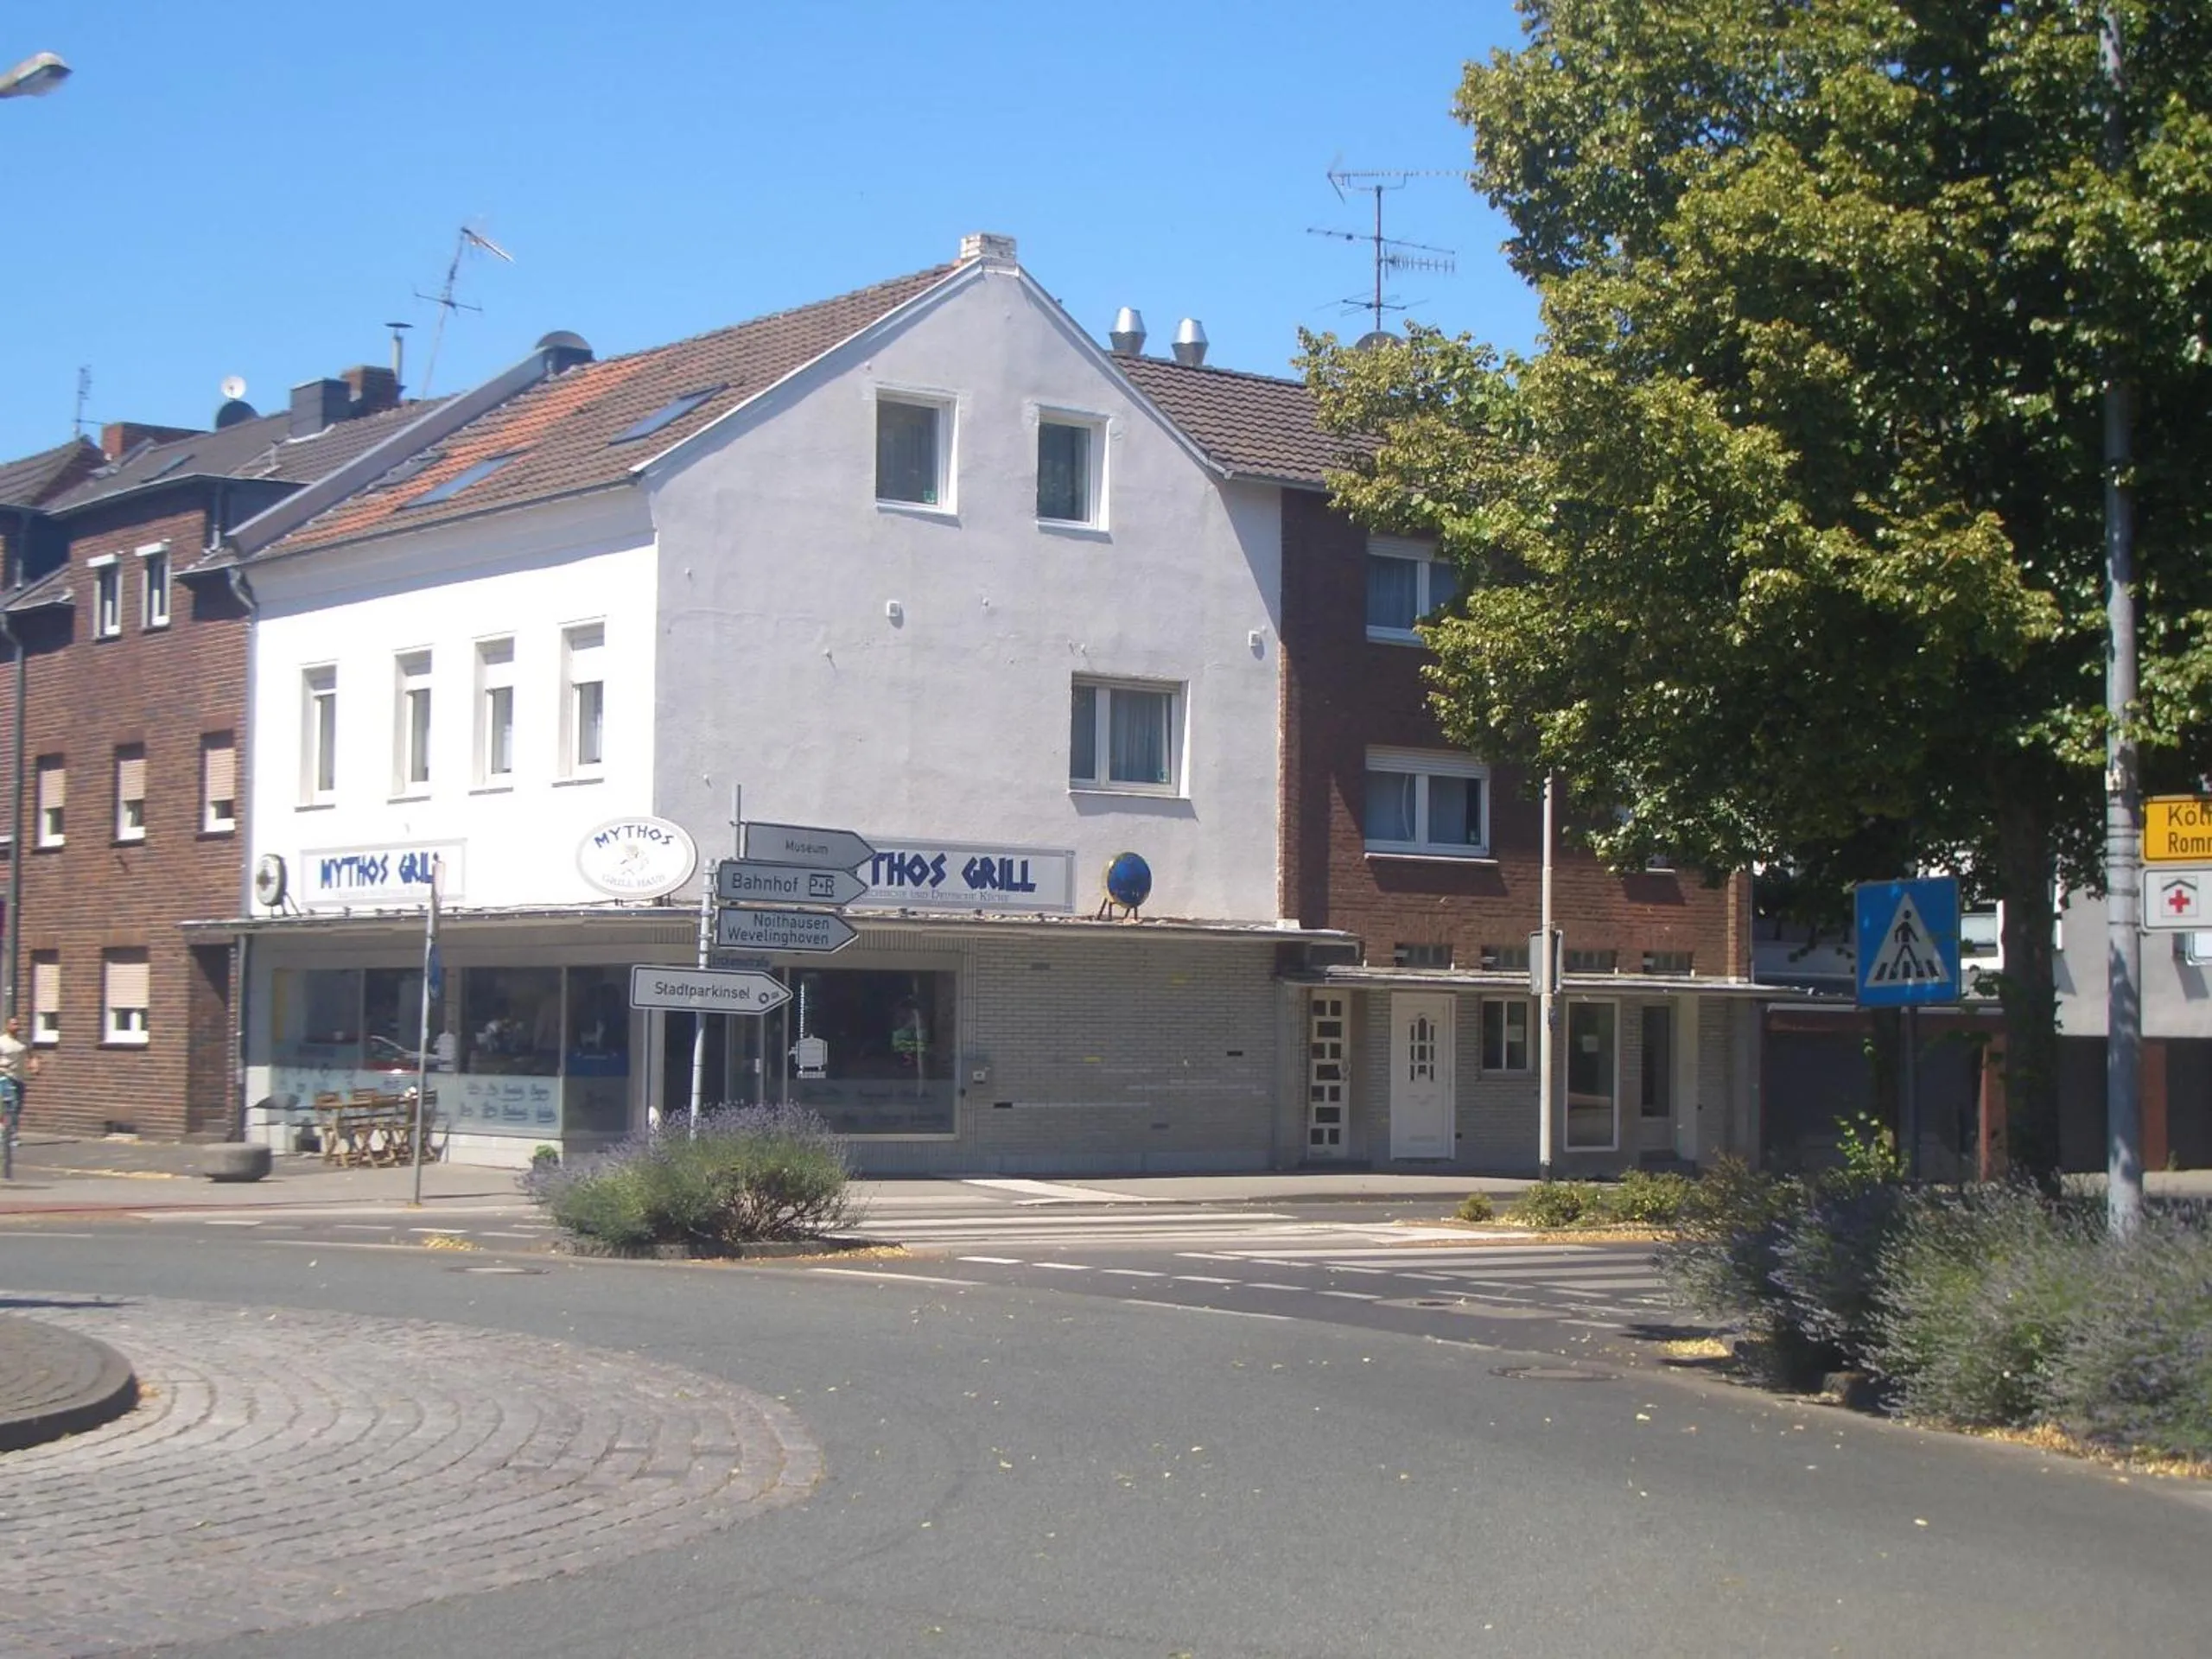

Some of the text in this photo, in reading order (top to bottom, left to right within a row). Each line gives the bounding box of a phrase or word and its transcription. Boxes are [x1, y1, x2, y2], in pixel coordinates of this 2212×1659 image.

[594, 824, 675, 849] MYTHOS
[785, 839, 829, 855] Museum
[321, 852, 389, 889] MYTHOS
[871, 852, 1037, 893] THOS GRILL
[732, 872, 798, 893] Bahnhof
[753, 913, 830, 931] Noithausen
[728, 925, 830, 946] Wevelinghoven
[654, 981, 750, 1000] Stadtparkinsel
